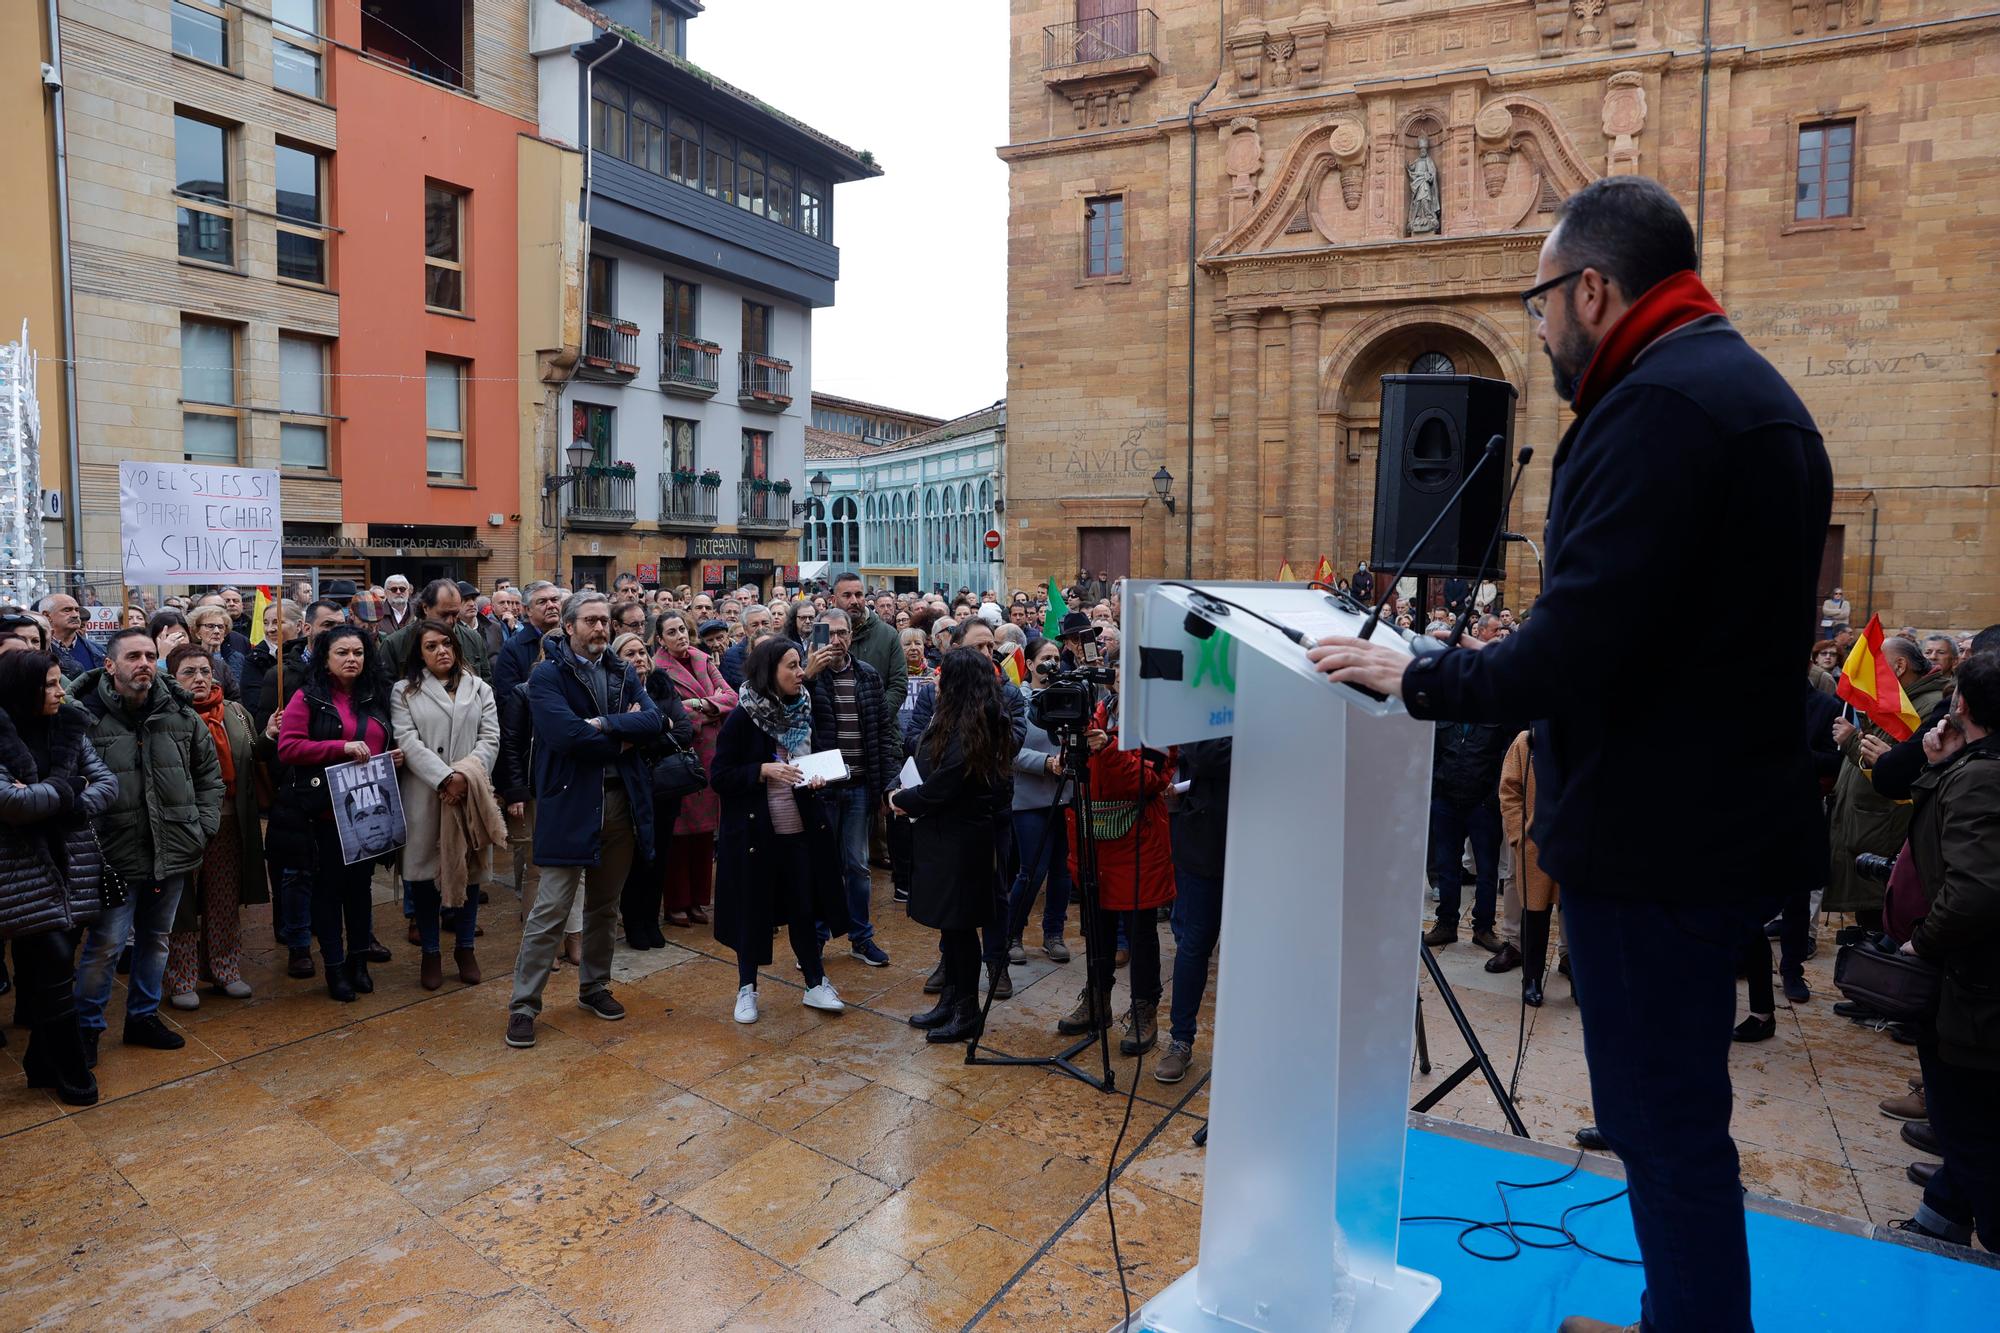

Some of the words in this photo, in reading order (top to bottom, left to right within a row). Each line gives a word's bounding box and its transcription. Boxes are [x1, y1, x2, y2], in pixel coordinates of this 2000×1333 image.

[125, 470, 149, 488] YO
[157, 471, 177, 491] EL
[221, 474, 242, 496] ES
[135, 502, 190, 526] PARA
[205, 505, 272, 528] ECHAR
[125, 539, 146, 569] A
[161, 534, 279, 572] SANCHEZ
[282, 535, 356, 547] FORMACION
[418, 538, 433, 548] DE
[435, 539, 485, 549] ASTURIAS
[86, 621, 119, 630] OFEME
[336, 758, 387, 793] ¡VETE
[349, 784, 382, 810] YA!
